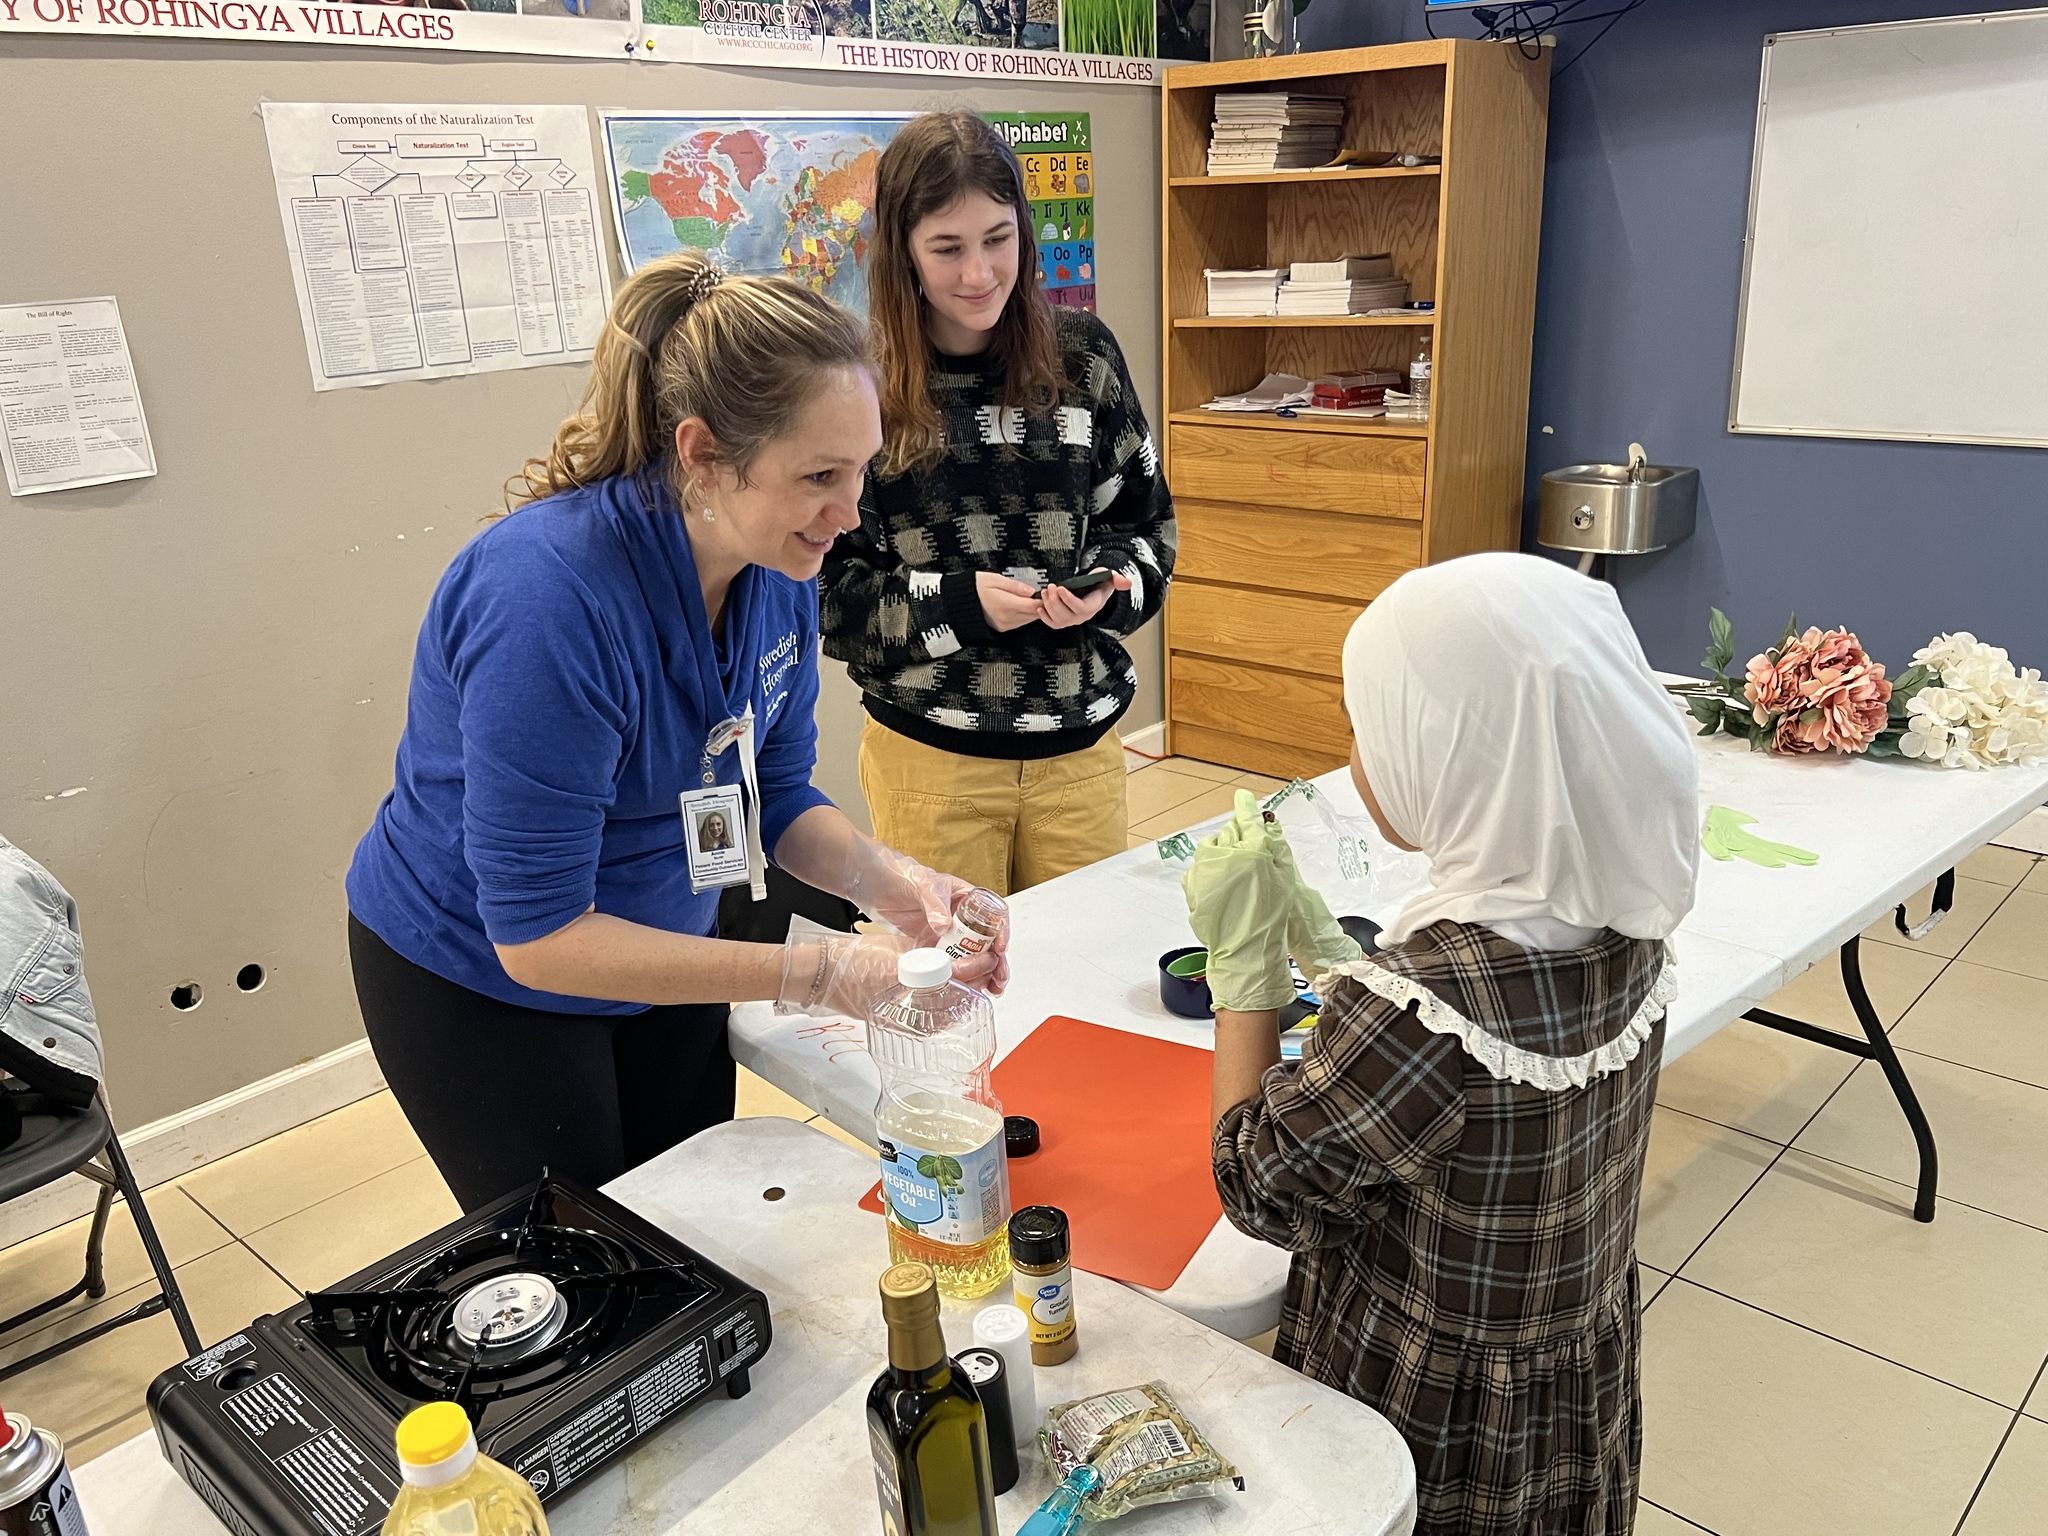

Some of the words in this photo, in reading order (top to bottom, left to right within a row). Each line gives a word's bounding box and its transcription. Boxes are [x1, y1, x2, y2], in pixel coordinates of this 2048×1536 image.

[33, 0, 83, 23] OF
[97, 0, 295, 32] ROHINGYA
[299, 7, 454, 40] VILLAGES
[699, 0, 811, 28] ROHINGYA
[703, 21, 761, 38] CULTURE
[764, 27, 812, 41] CENTER
[718, 38, 813, 52] WWW.RCCCHICAGO.ORG
[837, 44, 878, 66] THE
[881, 47, 960, 71] HISTORY
[965, 52, 987, 72] OF
[992, 54, 1079, 78] ROHINGYA
[1081, 59, 1153, 81] VILLAGES
[331, 113, 403, 128] Components
[405, 113, 418, 125] of
[419, 113, 437, 125] the
[440, 114, 513, 125] Naturalization
[514, 114, 534, 125] Test
[1075, 120, 1083, 132] X
[993, 121, 1068, 147] Alphabet
[1026, 157, 1040, 173] Cc
[1050, 156, 1067, 172] Dd
[1076, 156, 1089, 171] Ee
[1059, 202, 1068, 222] Jj
[1076, 200, 1091, 216] Kk
[1053, 247, 1070, 261] Oo
[1078, 245, 1093, 263] Pp
[1079, 288, 1094, 301] Uu
[759, 631, 797, 675] Swedish
[961, 938, 983, 952] BADIA
[897, 1164, 914, 1179] 100%
[882, 1169, 937, 1201] VEGETABLE
[1049, 1295, 1070, 1309] Ground
[549, 1424, 574, 1443] CARBON
[573, 1404, 603, 1427] MONOXIDE
[524, 1446, 549, 1467] DANGER
